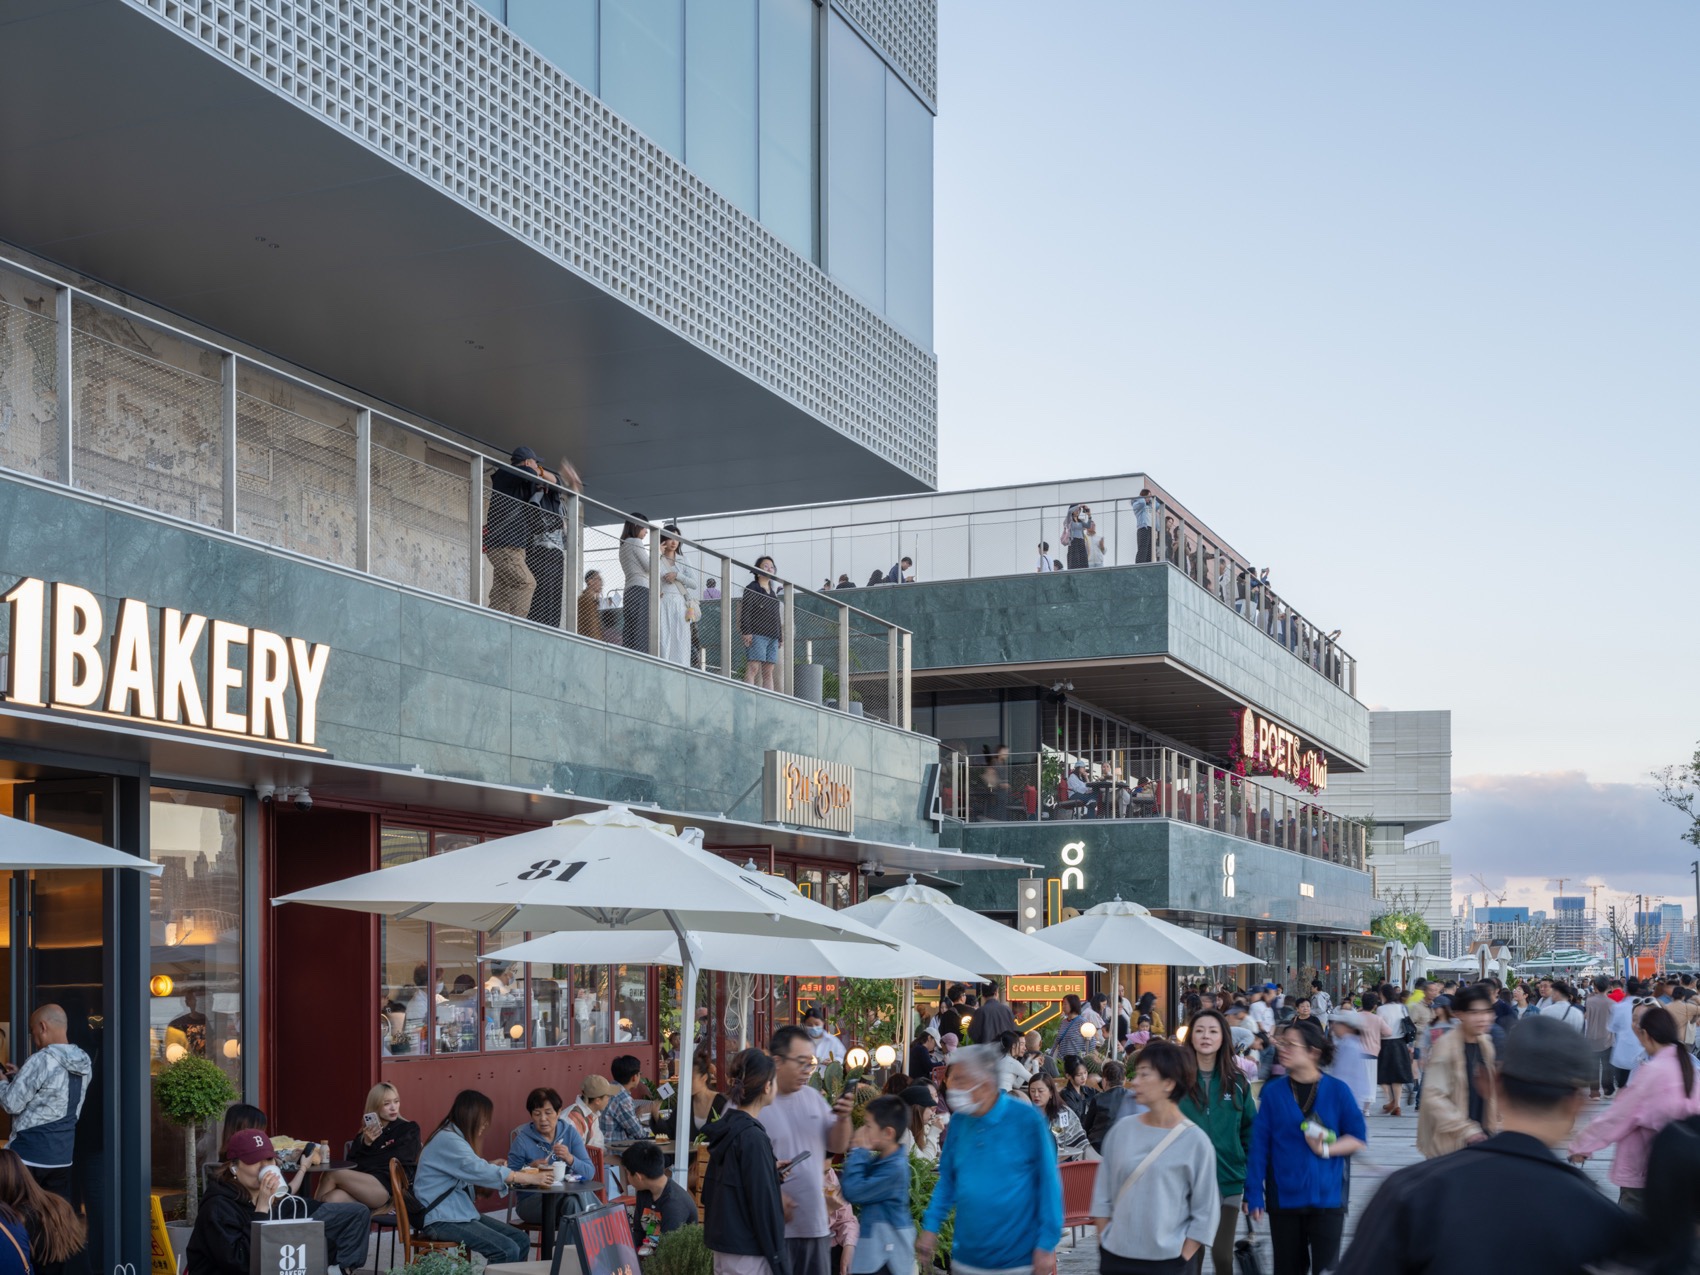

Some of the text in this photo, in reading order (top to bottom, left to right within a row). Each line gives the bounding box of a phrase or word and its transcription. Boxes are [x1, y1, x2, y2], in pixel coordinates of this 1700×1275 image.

[1258, 717, 1301, 779] POETS
[517, 859, 588, 882] 81
[1012, 984, 1081, 992] COME EAT PIE
[253, 1135, 264, 1147] B
[580, 1210, 635, 1265] AUTUMN
[279, 1244, 307, 1270] 81
